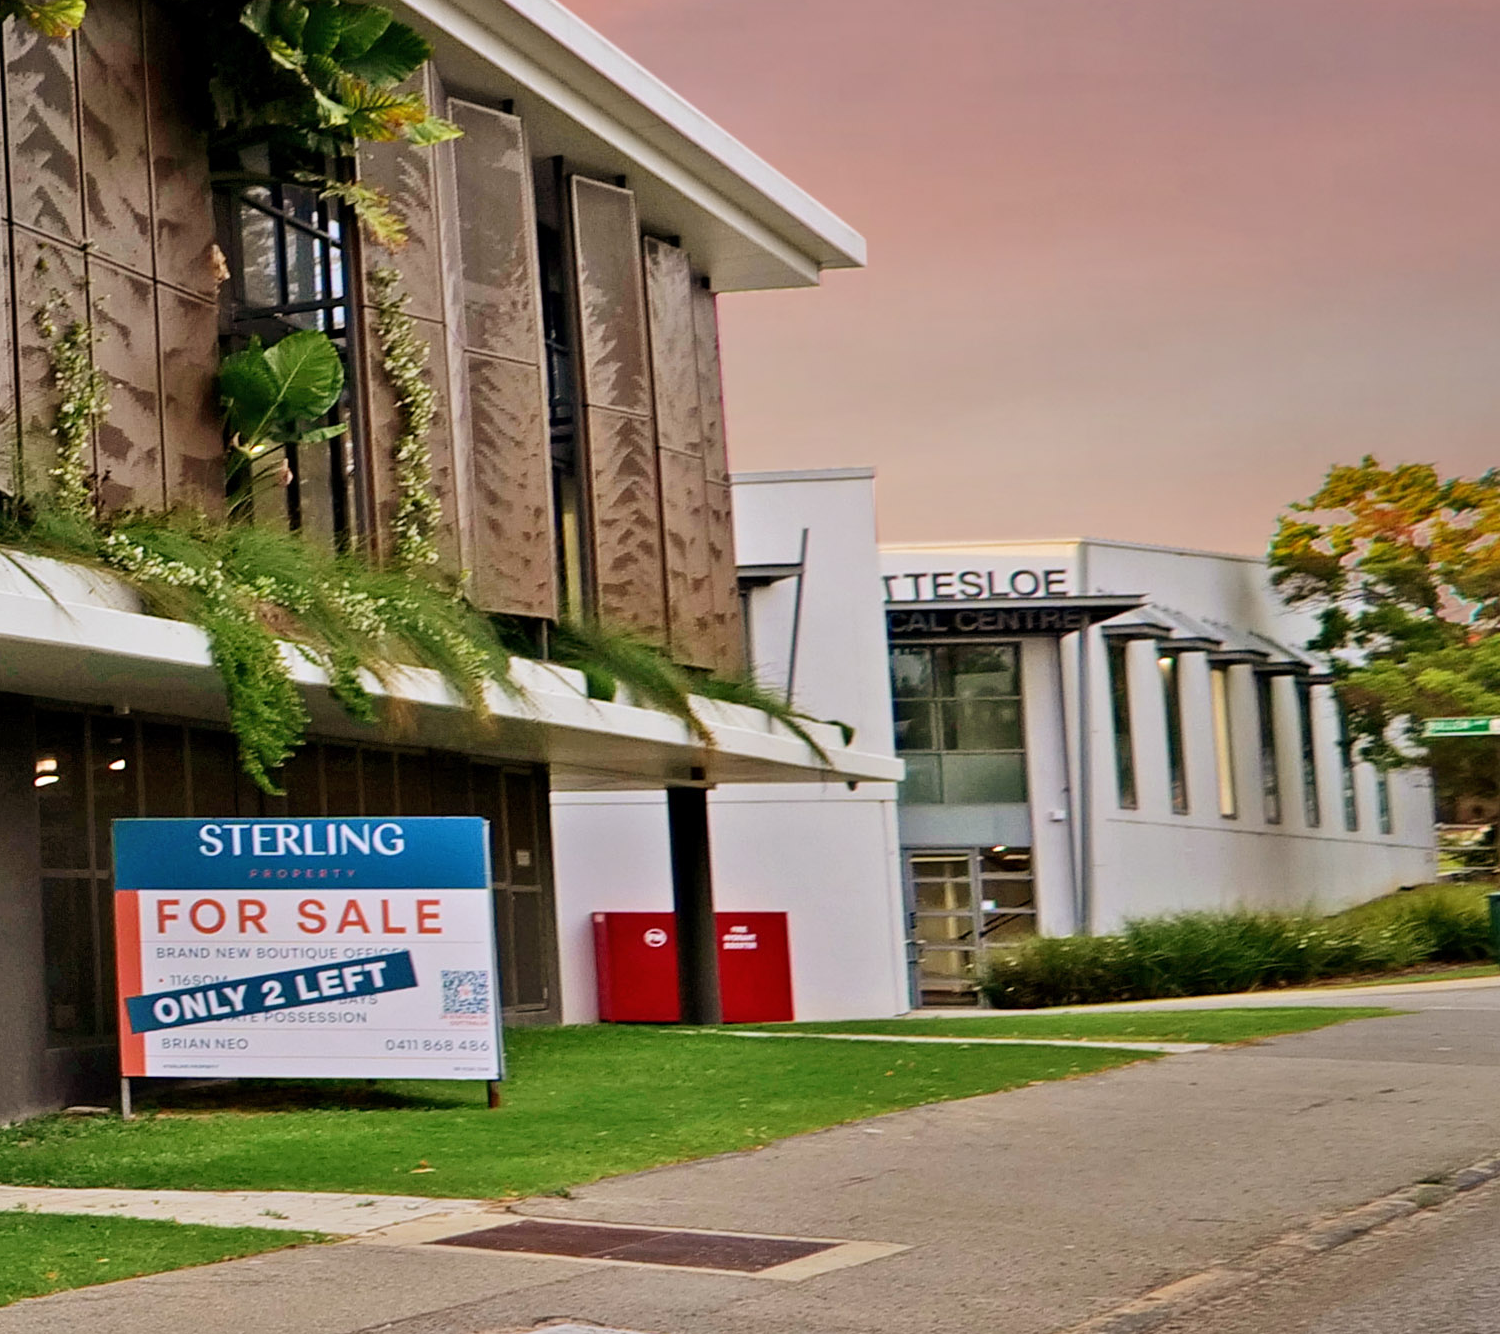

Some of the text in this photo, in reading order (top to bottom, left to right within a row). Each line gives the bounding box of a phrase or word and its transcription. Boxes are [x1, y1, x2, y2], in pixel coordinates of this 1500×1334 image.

[955, 607, 1089, 631] CENTRE
[199, 823, 405, 856] STERLING
[249, 868, 356, 879] PROPERTY
[156, 898, 443, 934] FOR SALE
[156, 947, 411, 961] BRAND NEW BOUTIQUE OFFIC
[153, 984, 248, 1024] ONLY
[261, 980, 286, 1006] 2
[294, 961, 387, 1000] LEFT
[264, 1011, 368, 1023] POSSESSION
[161, 1038, 249, 1050] BRIAN NEO
[385, 1039, 490, 1051] 0411 868 486
